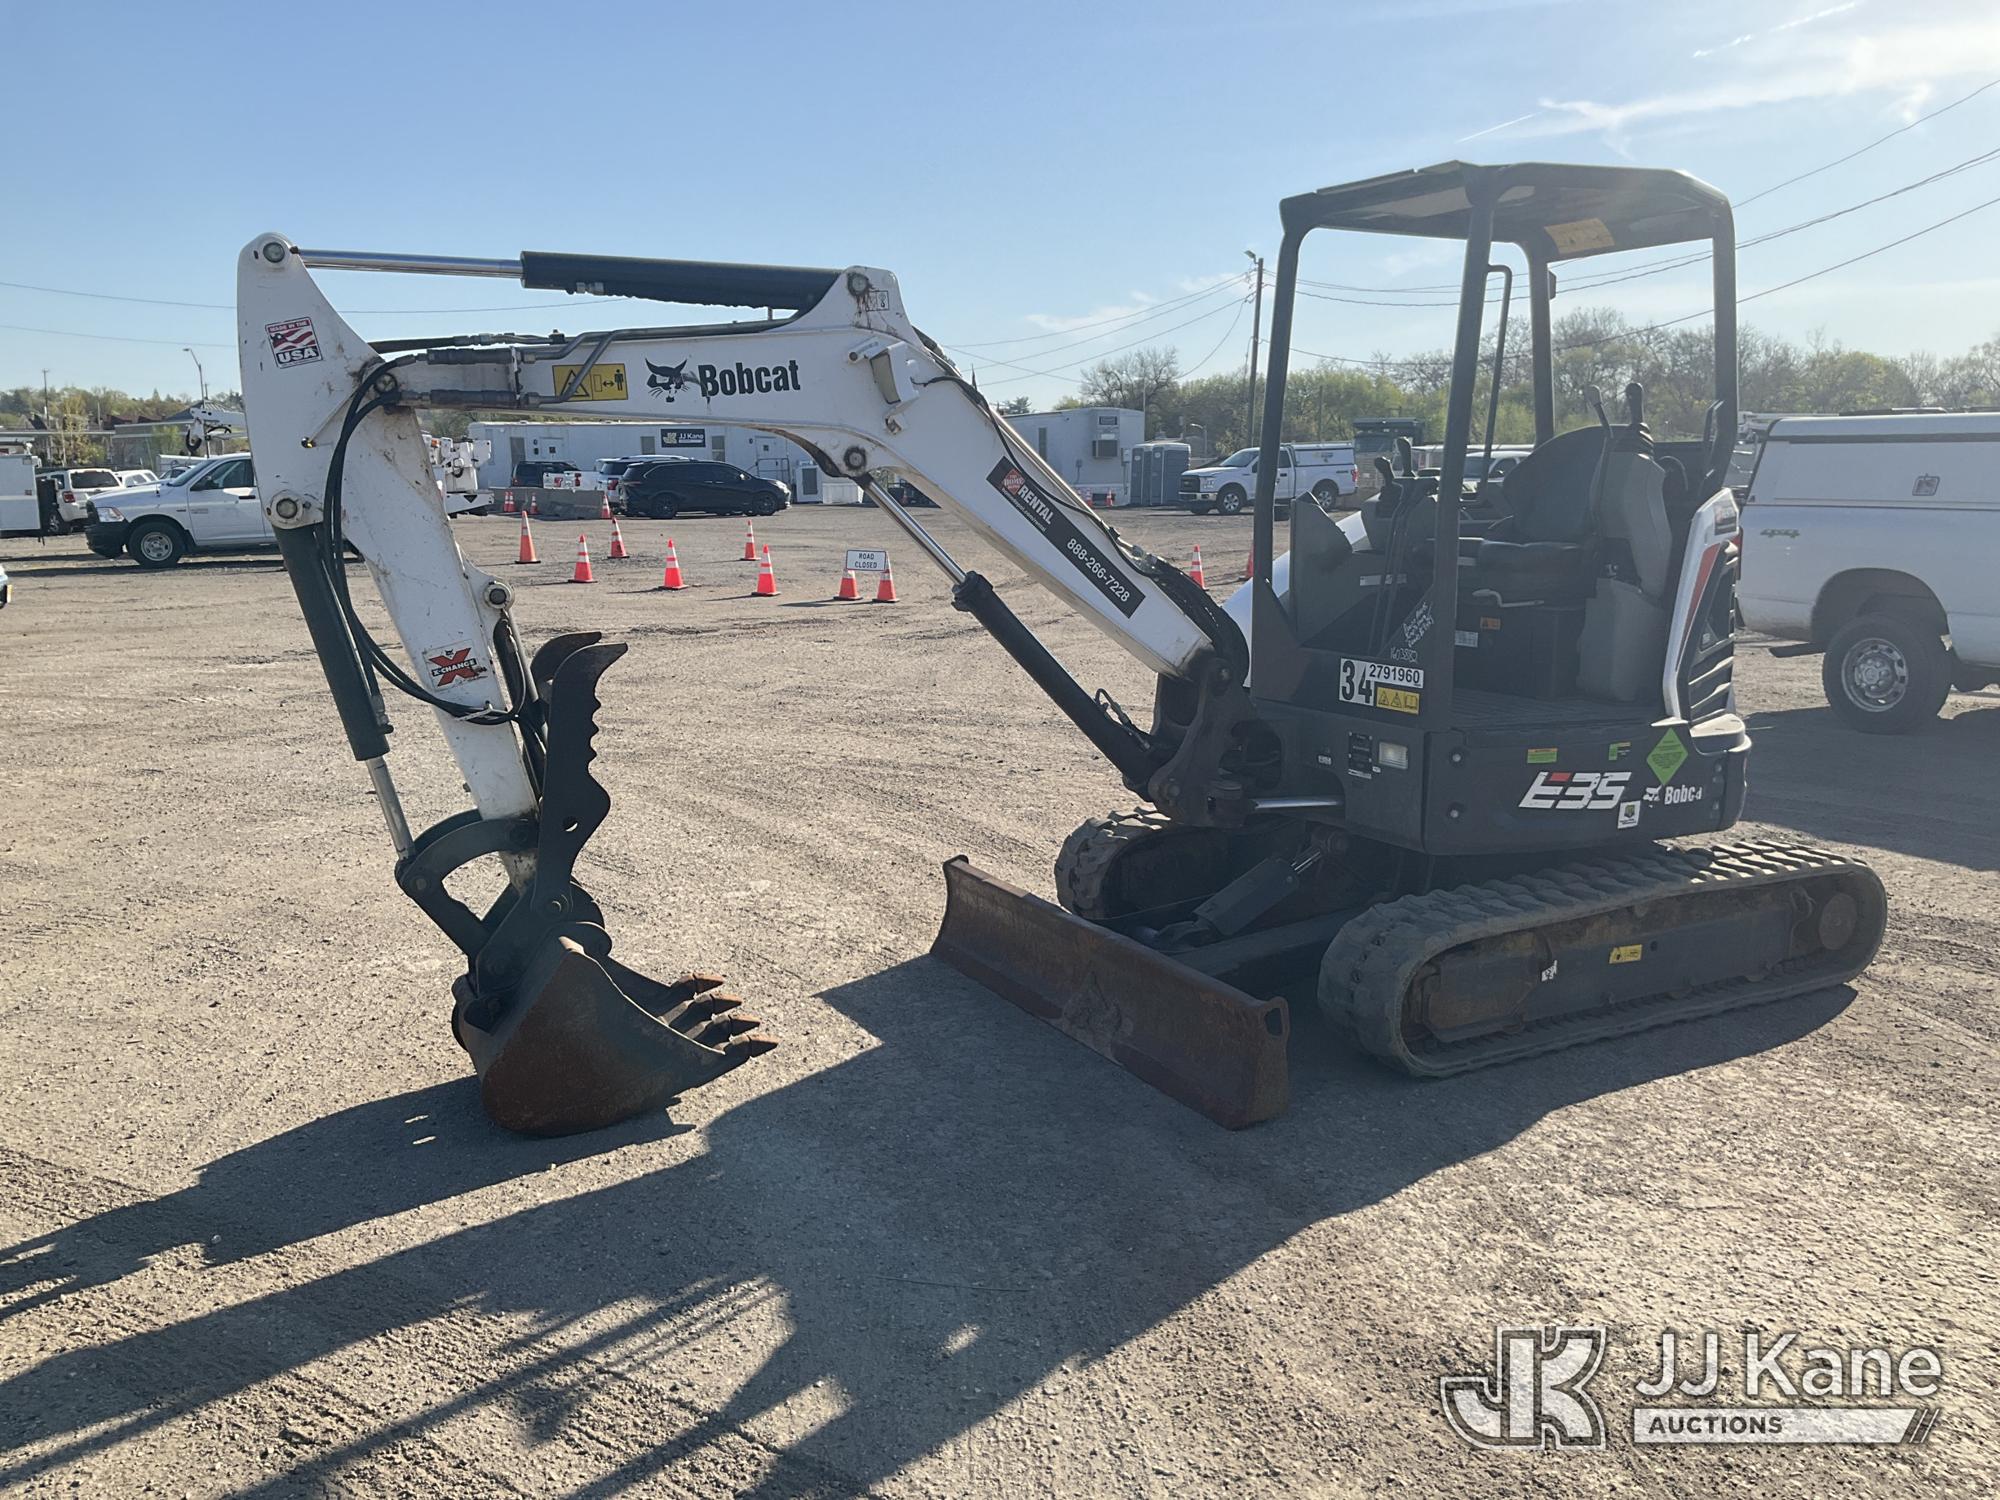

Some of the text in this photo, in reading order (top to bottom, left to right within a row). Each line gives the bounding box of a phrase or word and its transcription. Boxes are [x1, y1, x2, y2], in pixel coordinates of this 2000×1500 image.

[277, 348, 318, 363] USA
[698, 359, 800, 397] Bobcat
[1017, 484, 1054, 525] RENTAL
[854, 560, 878, 569] CLOSED
[858, 552, 875, 560] ROAD
[1066, 538, 1130, 602] 888-266-7228
[1341, 660, 1373, 704] 34
[1369, 664, 1421, 684] 2791960
[1518, 771, 1632, 809] E35
